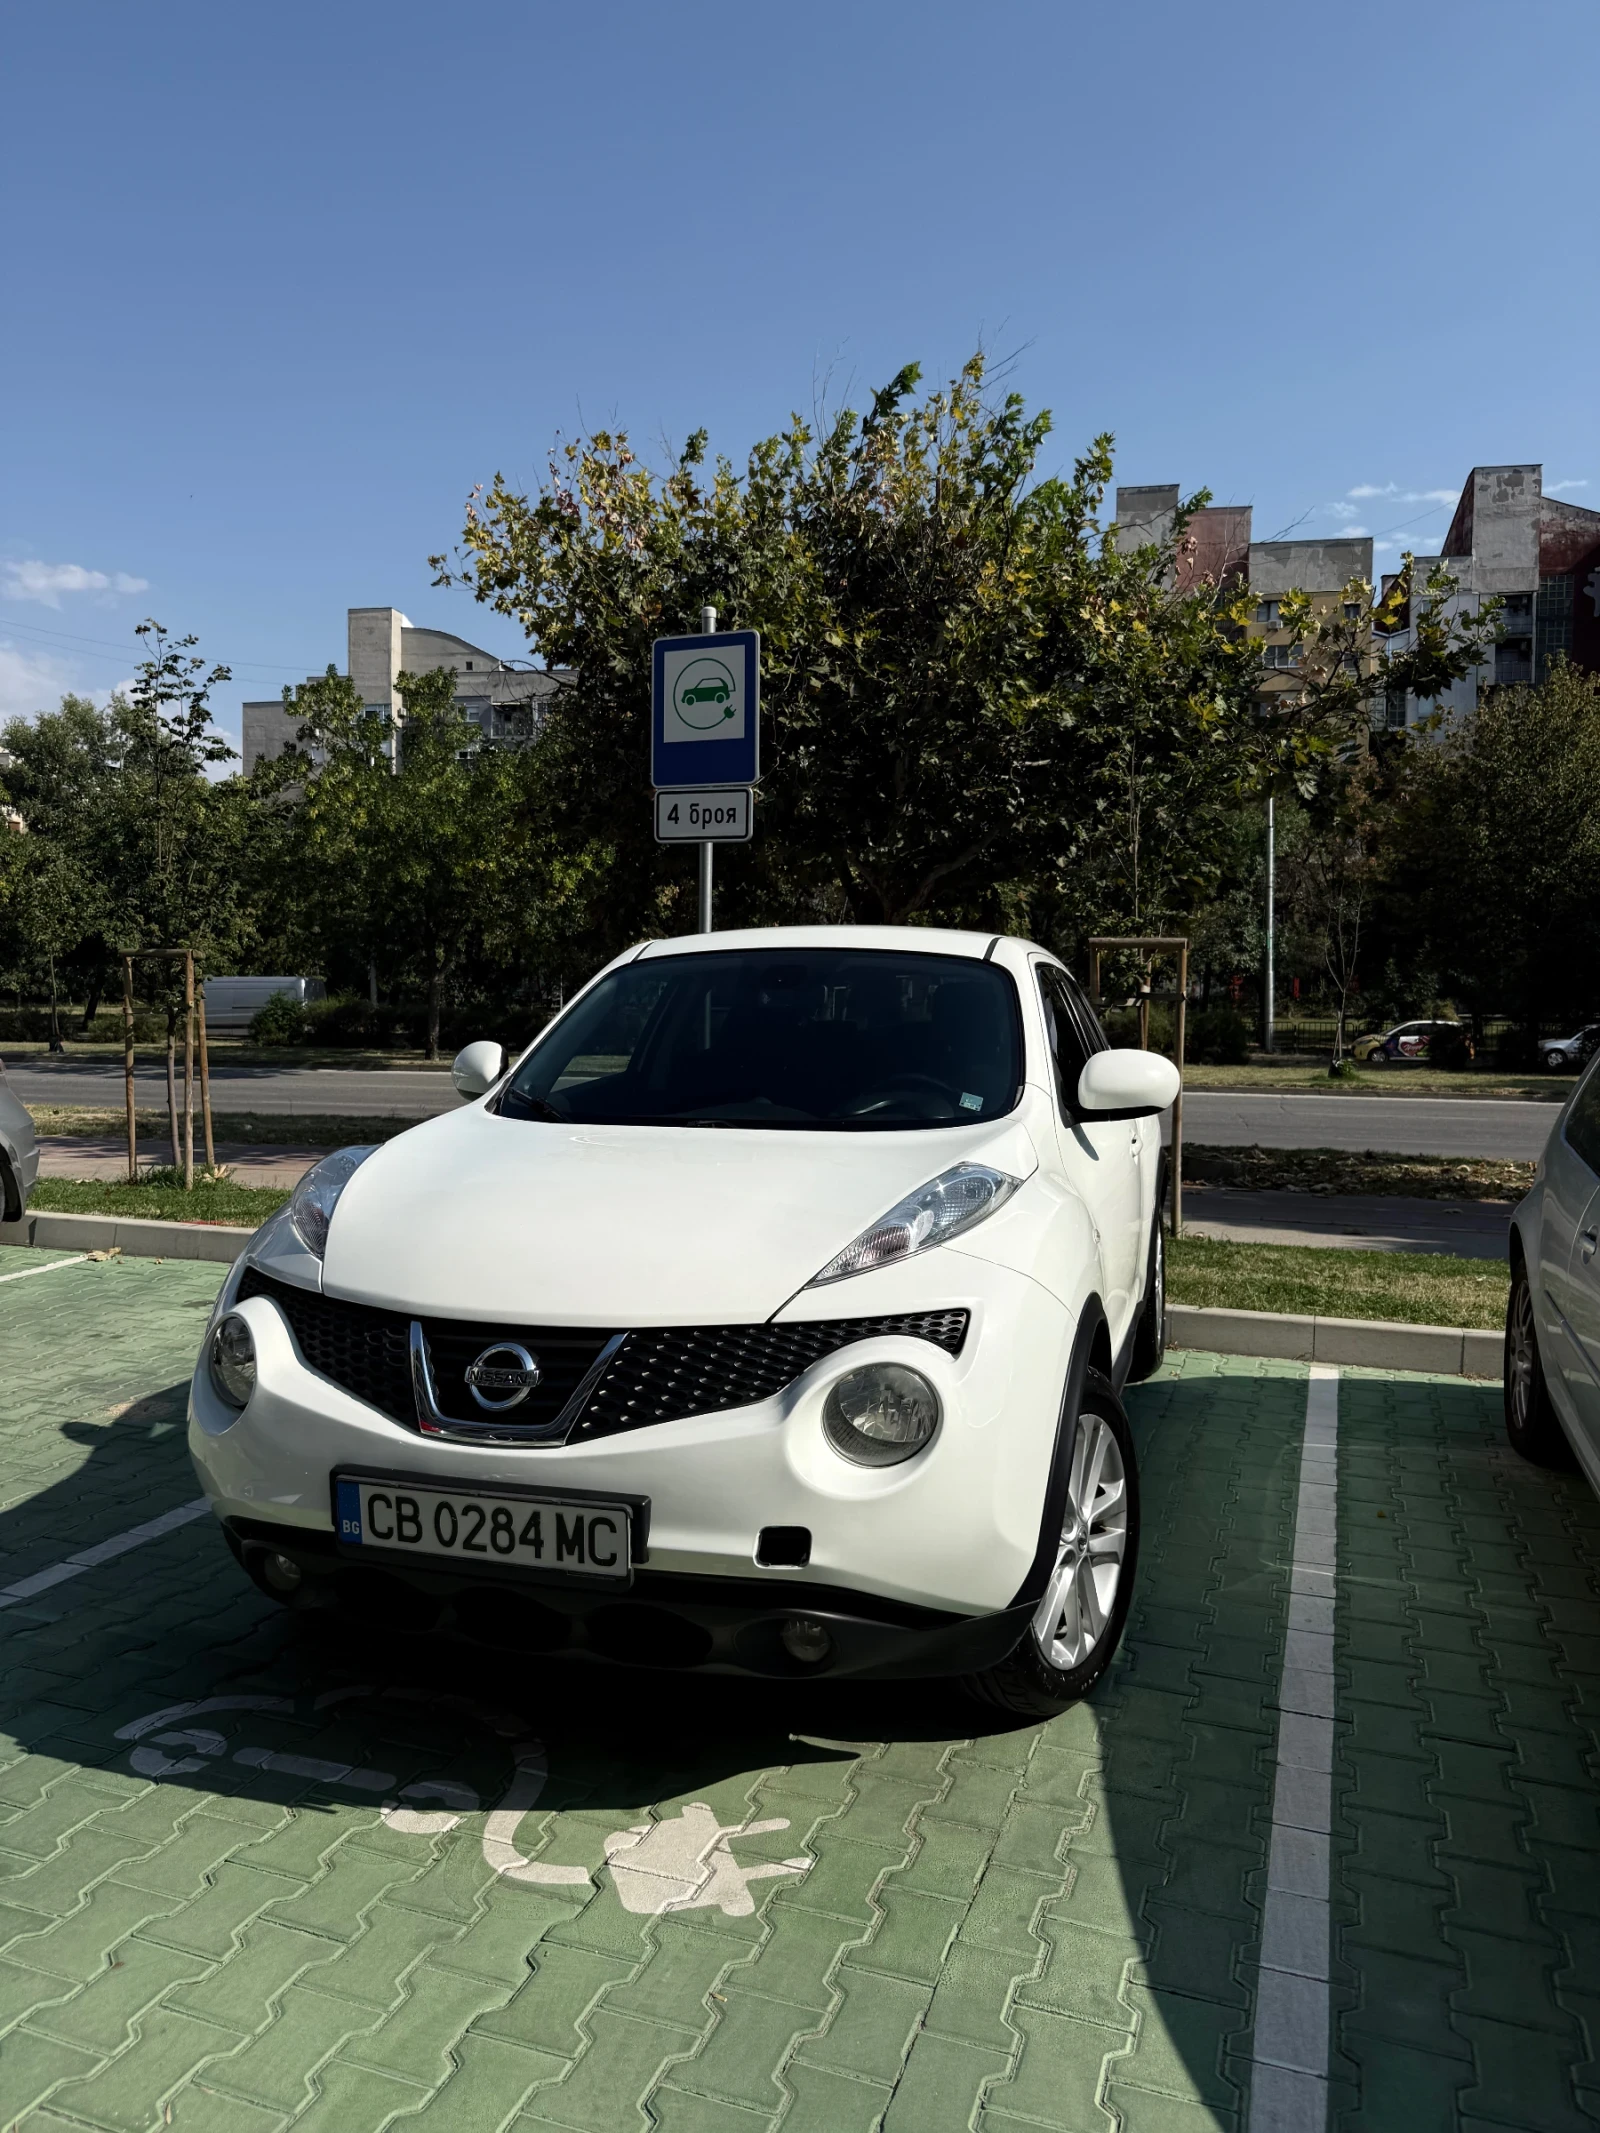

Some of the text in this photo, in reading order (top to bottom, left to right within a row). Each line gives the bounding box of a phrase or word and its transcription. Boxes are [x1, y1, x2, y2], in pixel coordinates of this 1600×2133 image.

[667, 803, 737, 830] 4 броя
[469, 1369, 529, 1384] NISSAN
[343, 1519, 361, 1535] BG
[368, 1493, 617, 1567] CB 0284 MC
